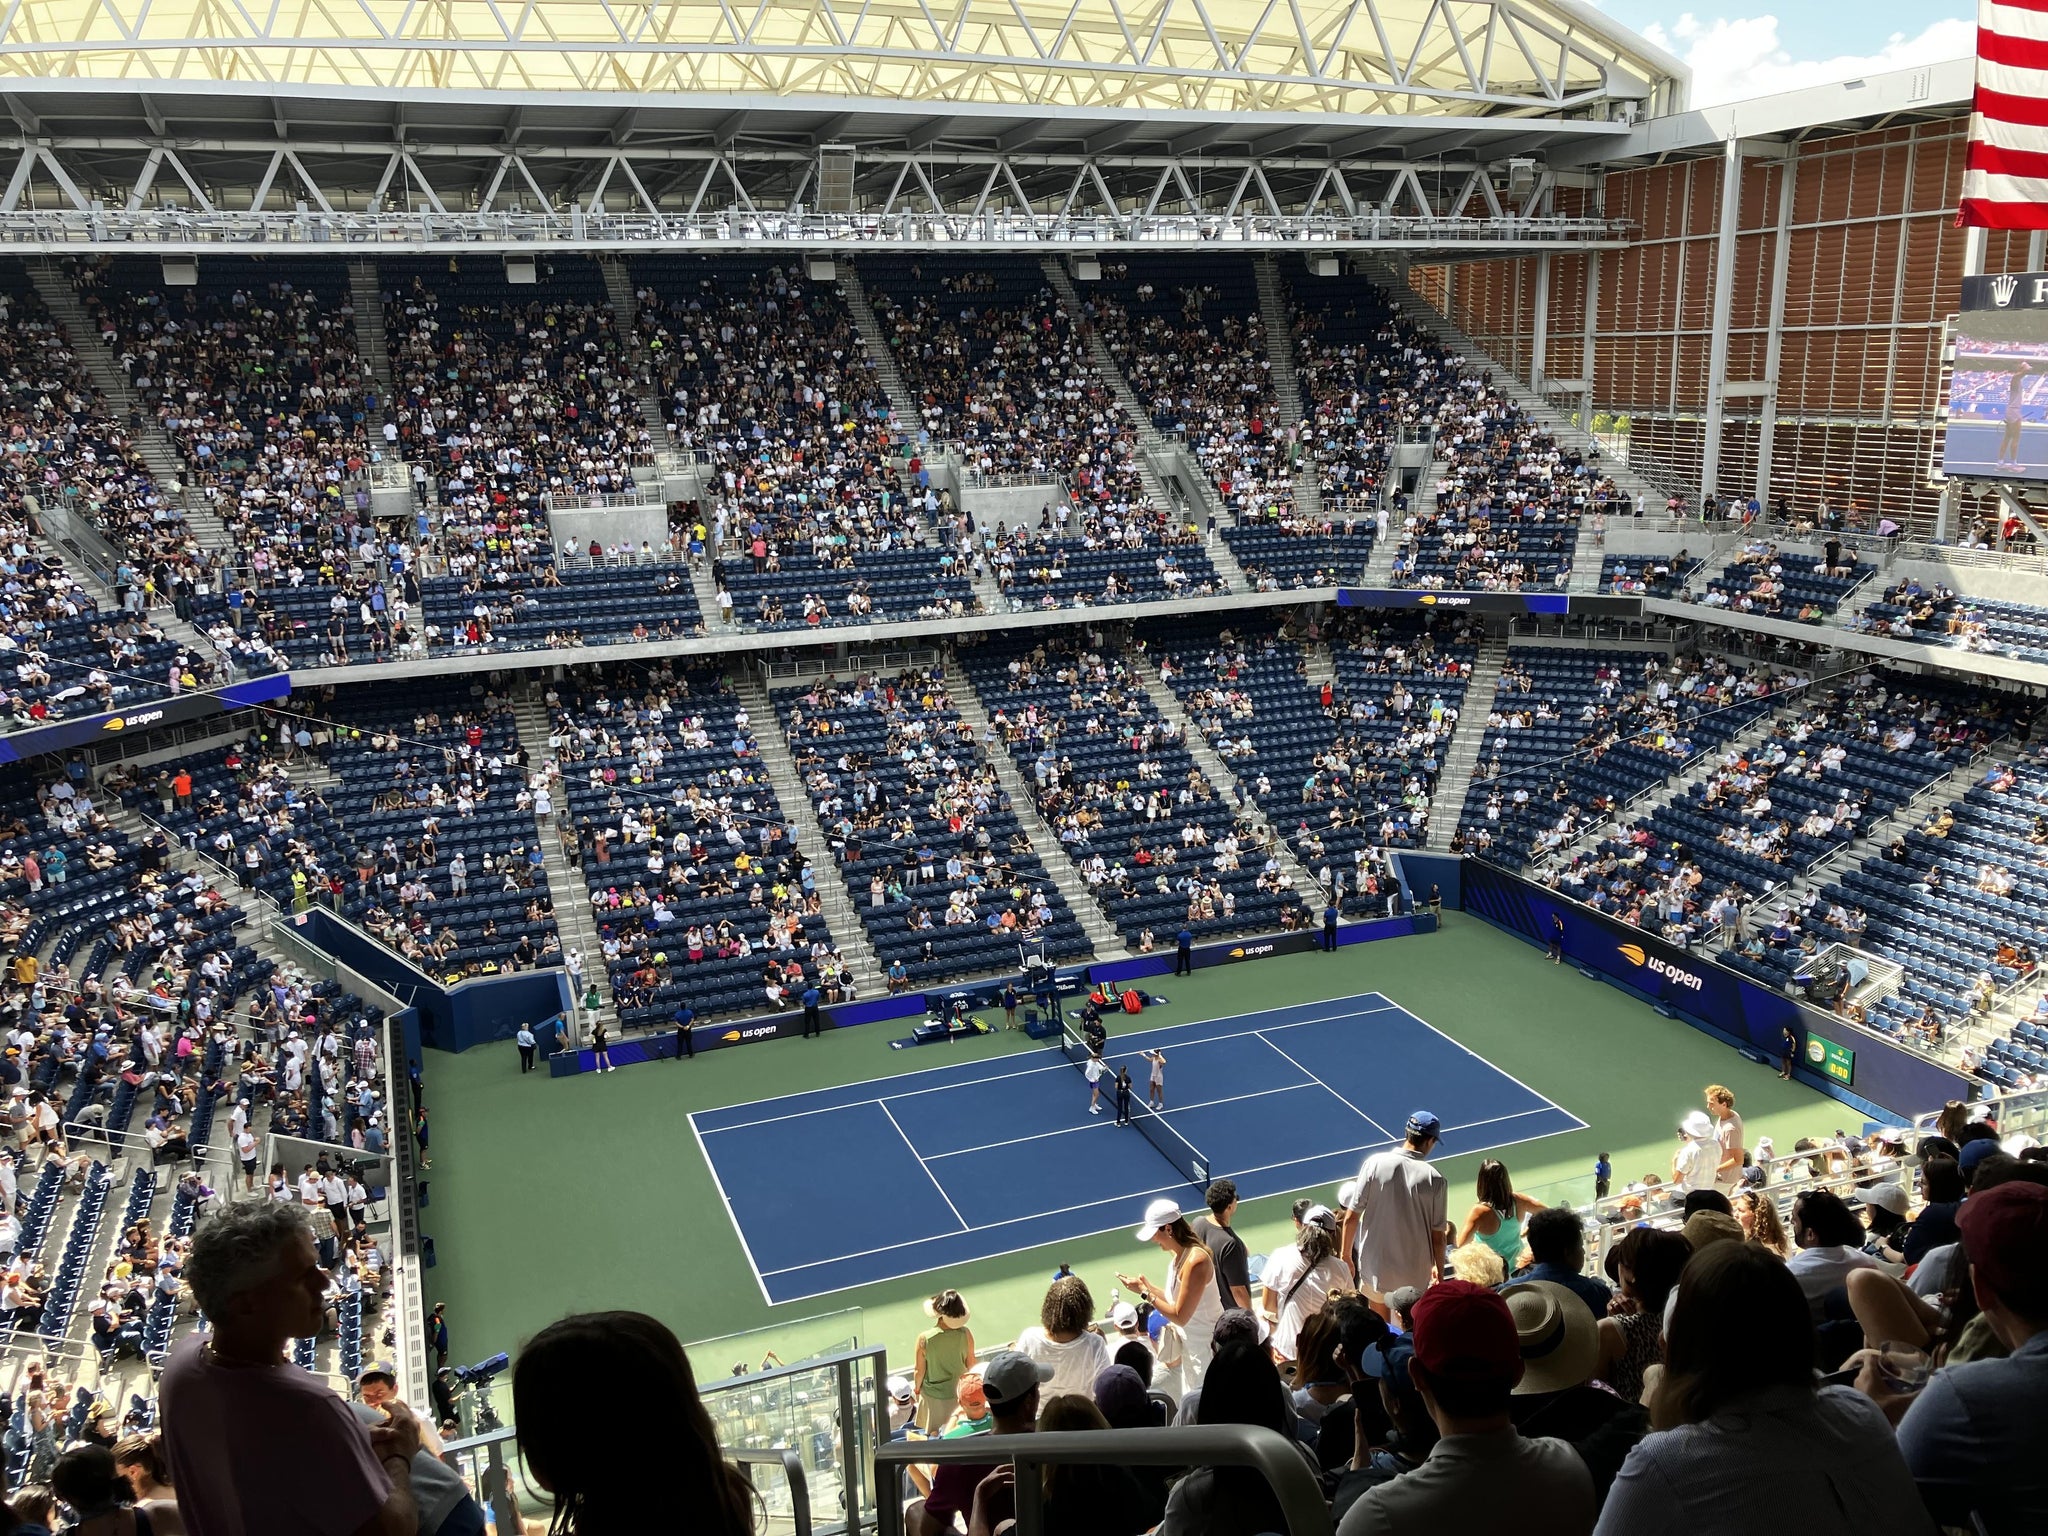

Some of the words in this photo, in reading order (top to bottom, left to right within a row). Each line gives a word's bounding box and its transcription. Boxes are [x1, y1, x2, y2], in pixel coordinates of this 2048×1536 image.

[1449, 597, 1471, 606] open
[126, 715, 138, 726] us
[138, 710, 163, 725] open
[1245, 947, 1254, 955] us
[1255, 944, 1273, 955] open
[1648, 956, 1665, 973] us
[1665, 965, 1703, 991] open
[742, 1029, 753, 1038] us
[753, 1025, 777, 1037] open
[1831, 1063, 1848, 1079] 0:00
